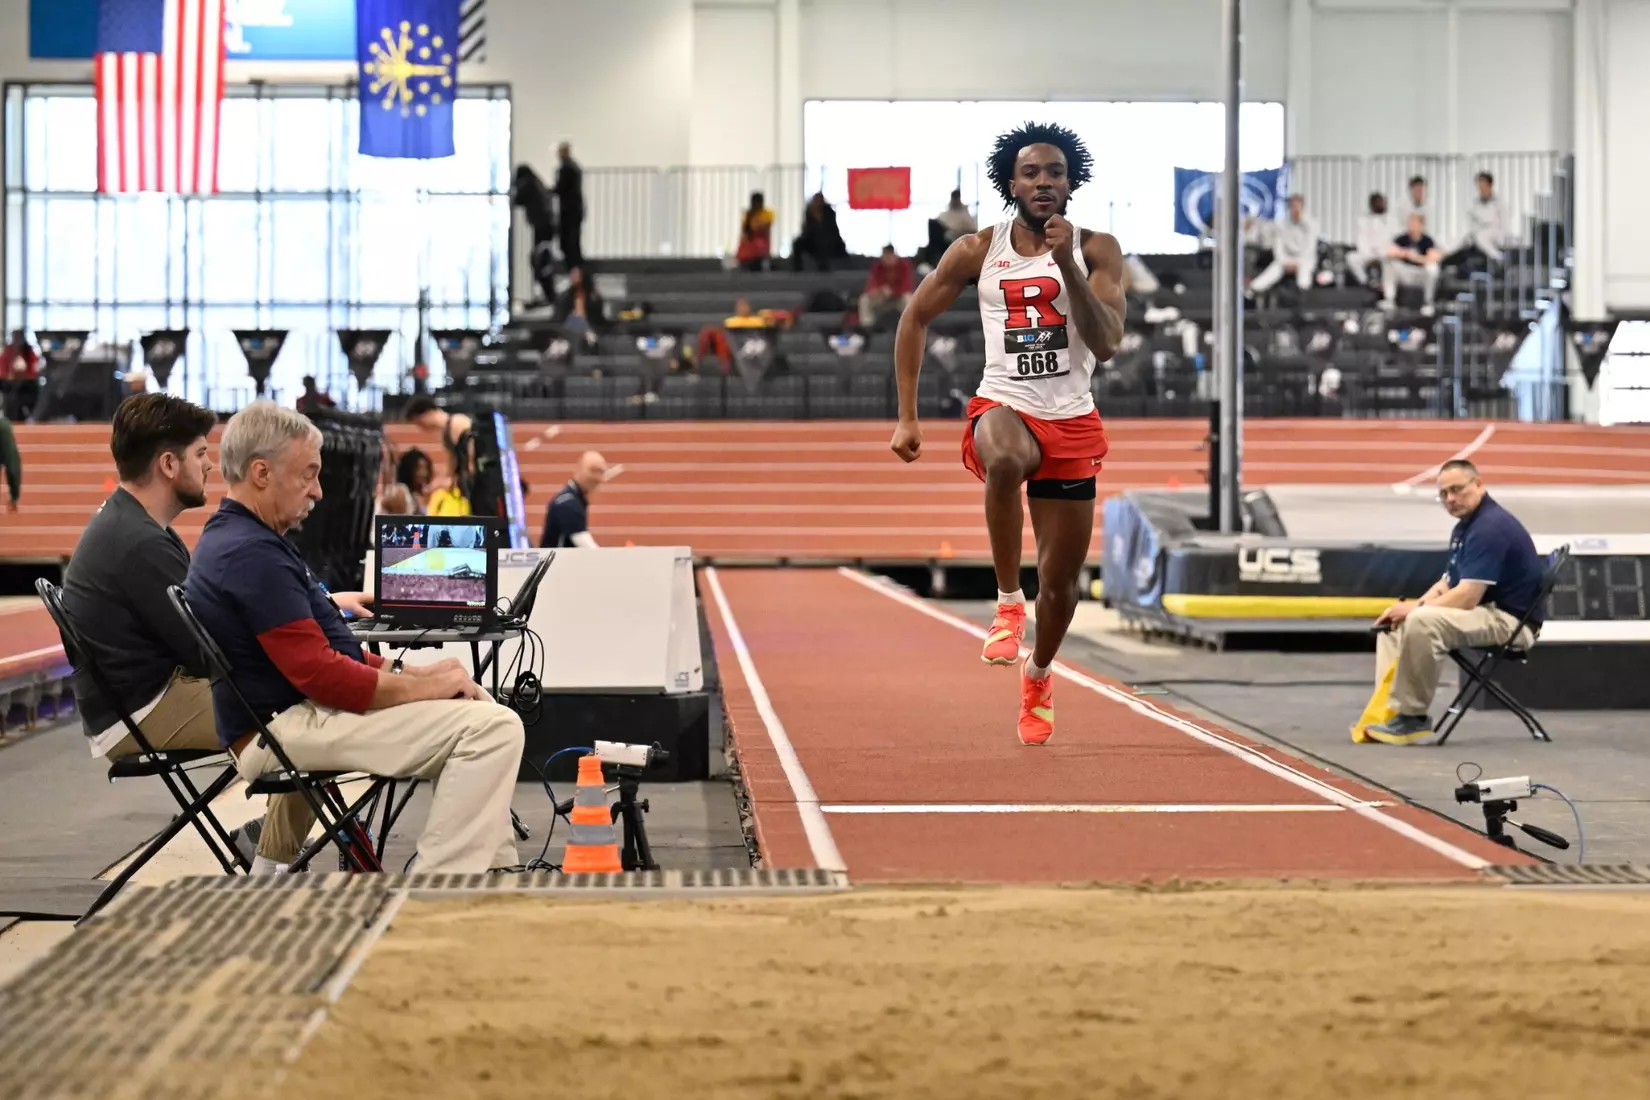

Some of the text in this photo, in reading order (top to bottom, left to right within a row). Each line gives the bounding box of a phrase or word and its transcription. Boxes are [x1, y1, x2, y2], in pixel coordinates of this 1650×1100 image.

[999, 276, 1067, 329] R
[1016, 351, 1059, 375] 668
[1238, 547, 1321, 573] UCS
